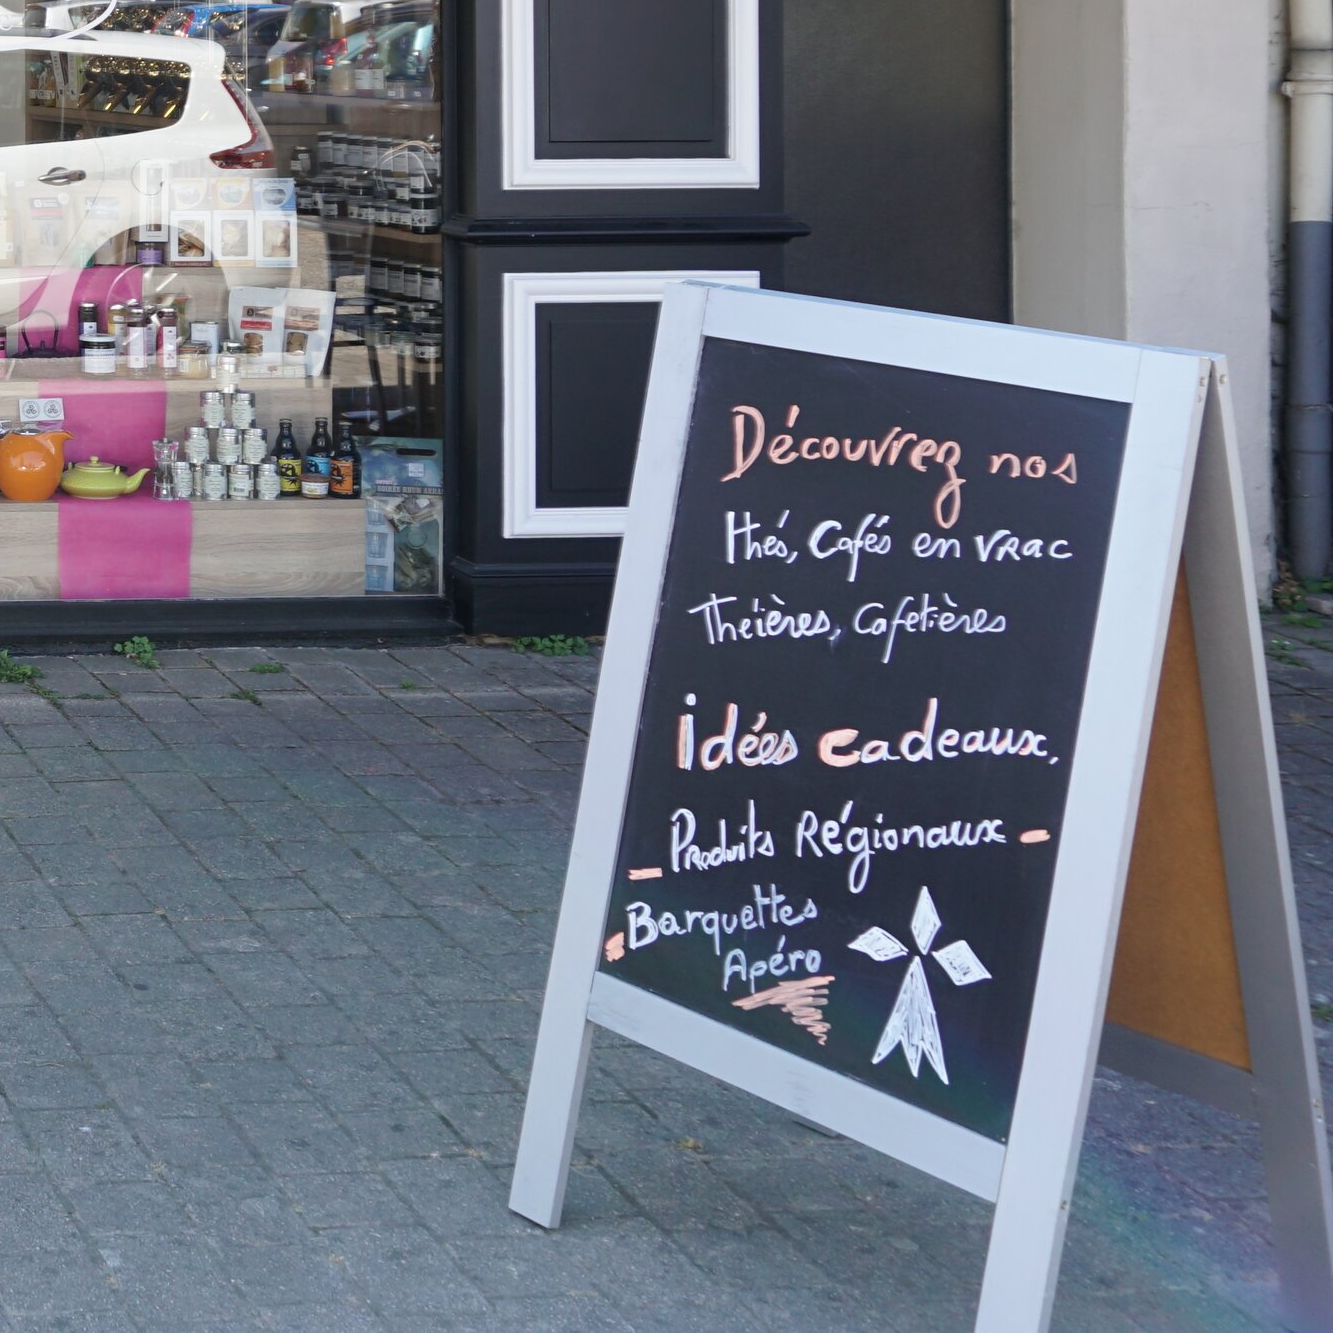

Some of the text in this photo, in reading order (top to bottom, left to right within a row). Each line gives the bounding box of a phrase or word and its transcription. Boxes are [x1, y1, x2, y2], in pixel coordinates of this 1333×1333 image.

[720, 404, 1077, 529] Découvrez nos
[911, 532, 961, 559] en
[796, 800, 1008, 894] Régionaux
[625, 883, 819, 956] Barquettes
[722, 935, 822, 993] Apéro
